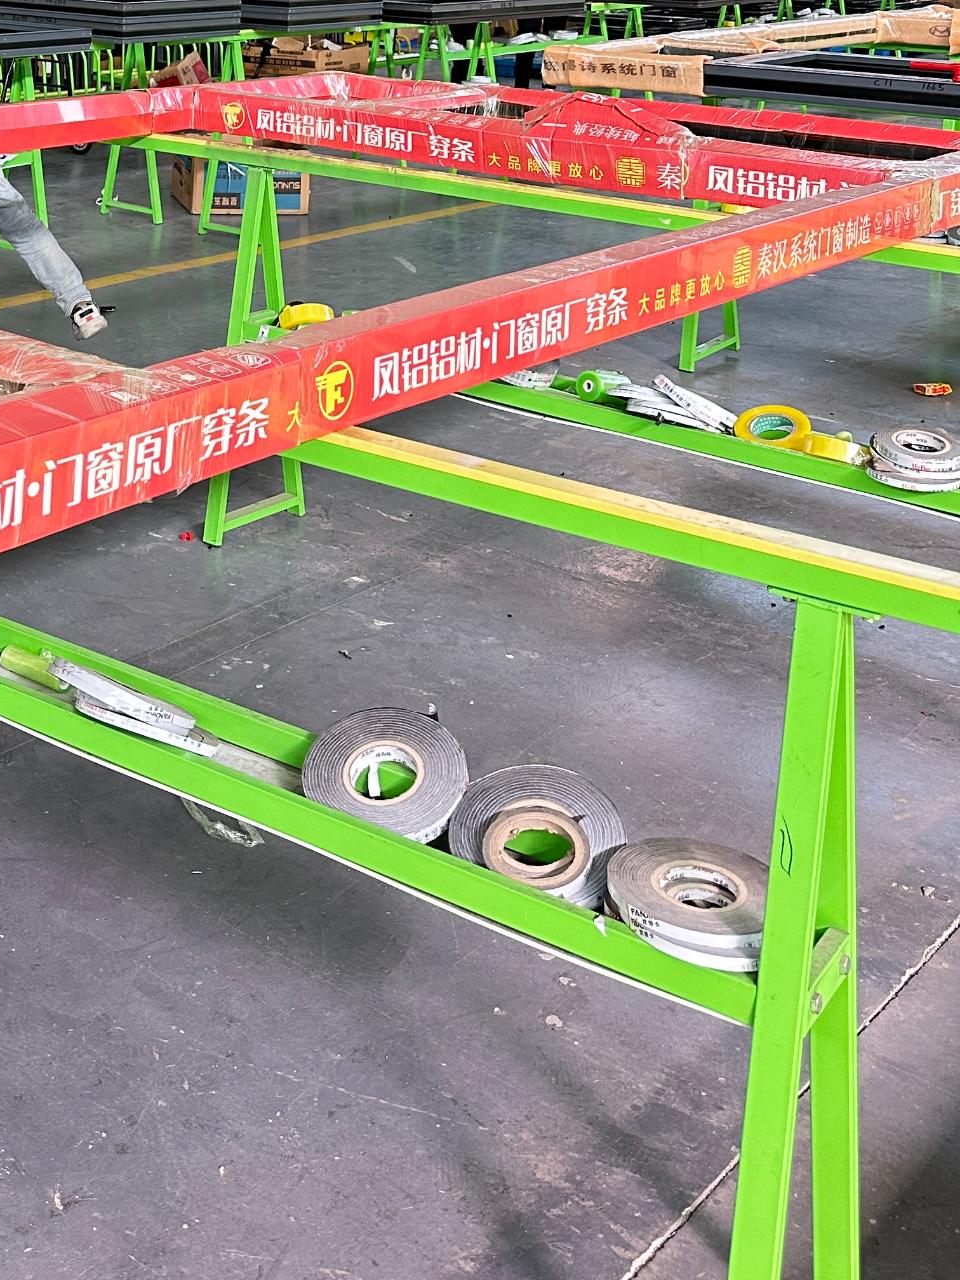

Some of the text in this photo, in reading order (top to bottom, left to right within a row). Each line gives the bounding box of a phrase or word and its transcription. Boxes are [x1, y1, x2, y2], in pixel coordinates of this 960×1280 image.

[372, 285, 629, 403] 凤铝铝材·门窗原厂穿条
[638, 271, 726, 317] 大品牌更放心
[757, 215, 872, 279] 秦汉系统门窗制造
